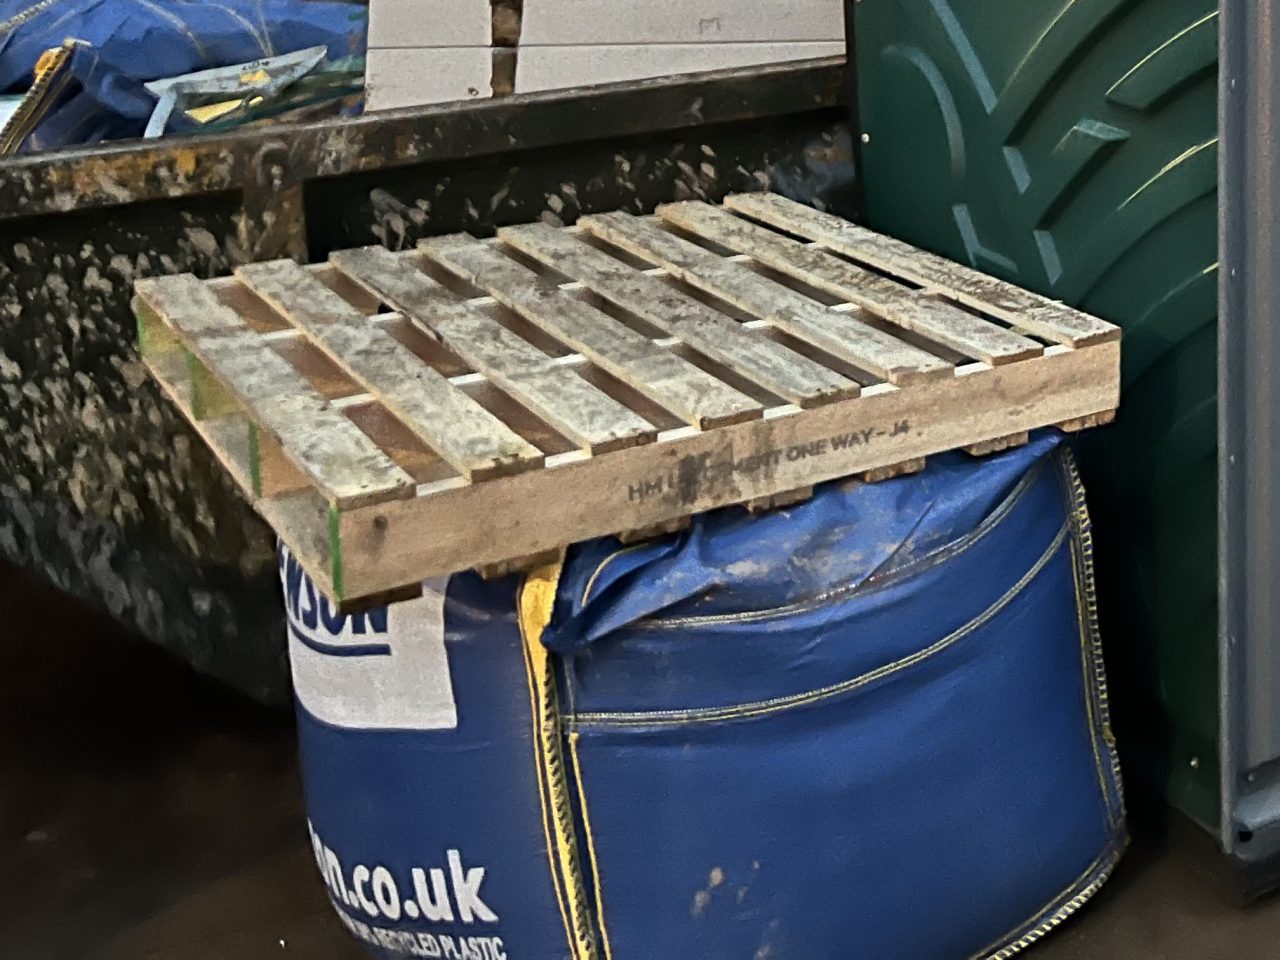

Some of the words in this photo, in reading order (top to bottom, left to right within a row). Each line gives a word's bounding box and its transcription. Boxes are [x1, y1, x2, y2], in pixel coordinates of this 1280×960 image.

[786, 439, 827, 461] ONE
[831, 427, 875, 450] WAY
[438, 934, 508, 960] PLASTIC
